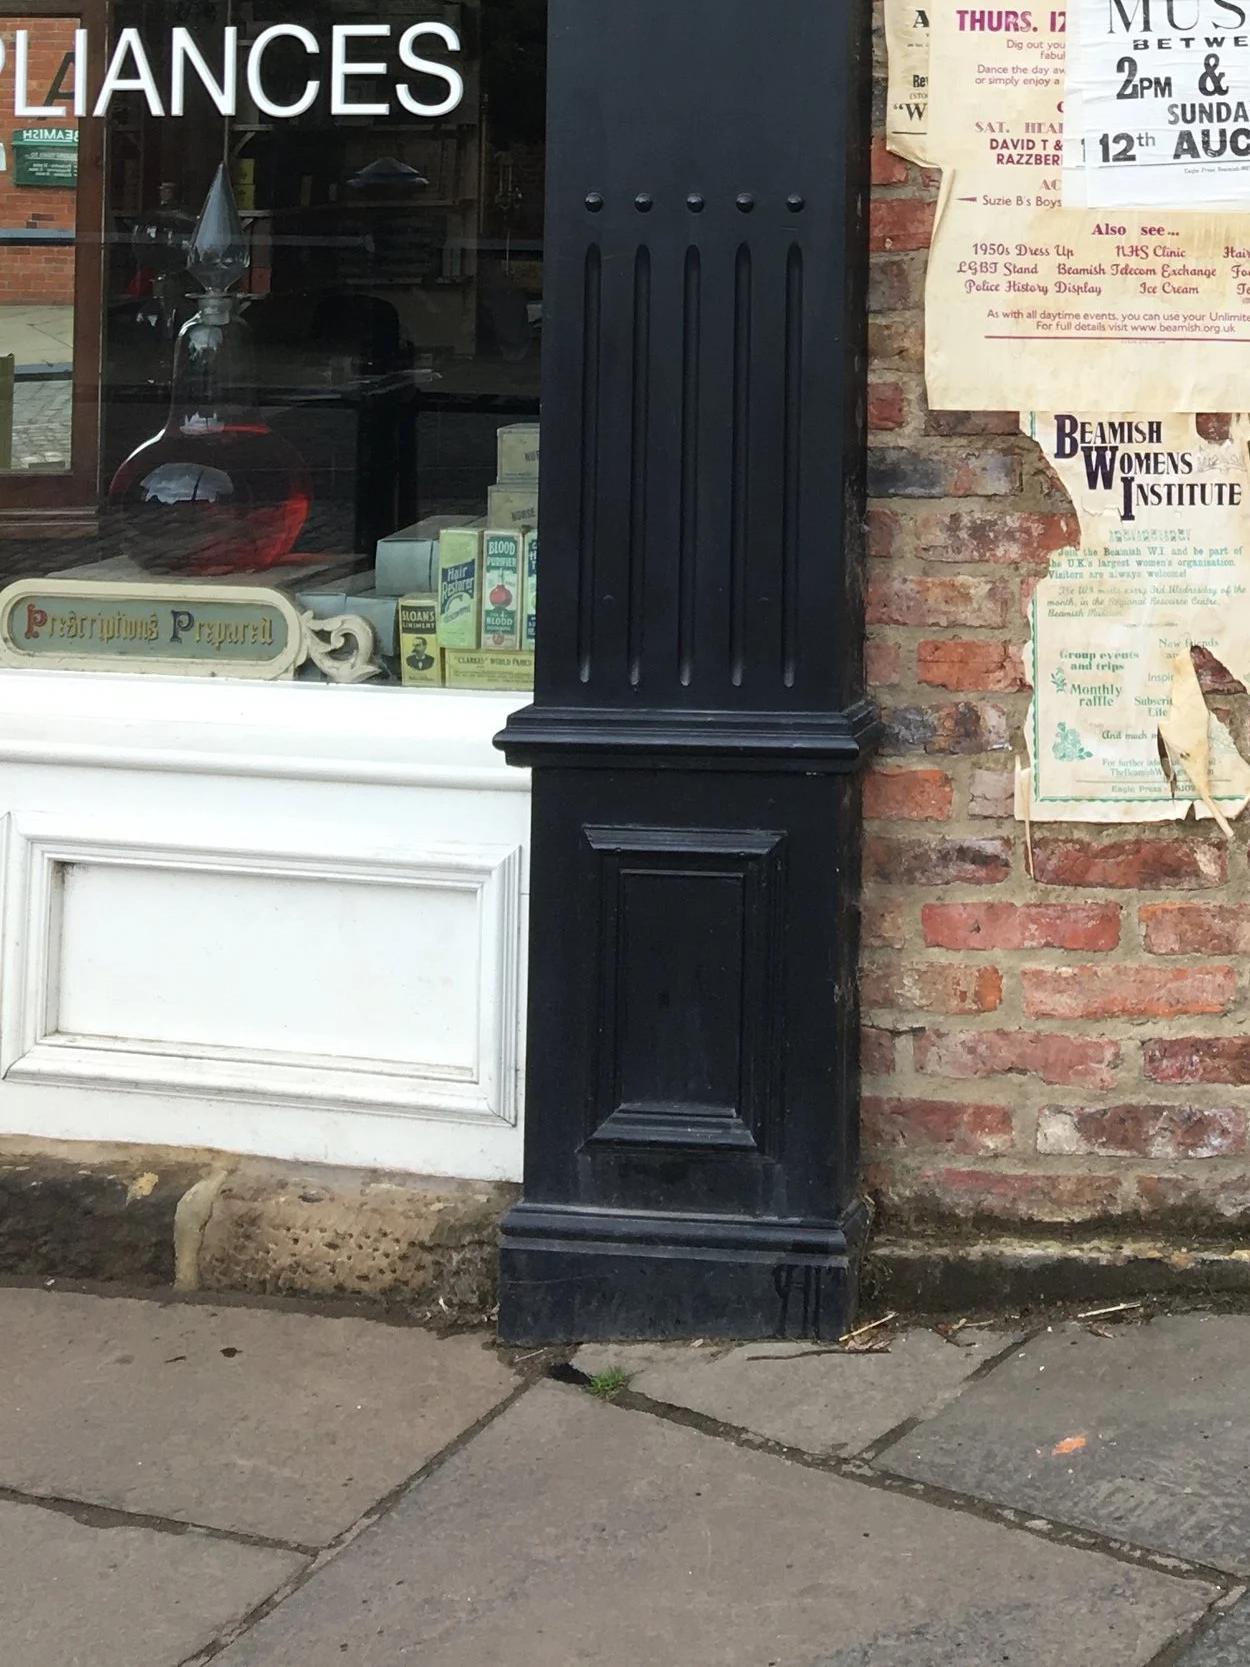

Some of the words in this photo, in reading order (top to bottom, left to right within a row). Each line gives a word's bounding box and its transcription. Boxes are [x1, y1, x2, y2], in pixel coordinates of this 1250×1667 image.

[956, 10, 1038, 32] THURS.
[1007, 39, 1023, 50] Dig
[1027, 40, 1043, 49] out
[0, 22, 464, 118] LIANCES
[978, 65, 1008, 74] Dance
[1012, 65, 1028, 74] the
[1032, 65, 1049, 76] day
[989, 75, 1019, 87] simply
[1023, 76, 1049, 86] enjoy
[1116, 56, 1172, 100] 2PM
[1198, 53, 1229, 96] &
[975, 122, 1010, 133] SAT.
[990, 139, 1035, 150] DAVID
[1041, 140, 1049, 150] T
[1054, 139, 1063, 150] &
[1099, 132, 1156, 163] 12th
[997, 154, 1062, 166] RAZZBER
[982, 195, 1011, 206] Suzie
[1036, 196, 1062, 207] Boys
[1092, 223, 1126, 236] Also
[972, 243, 1011, 256] 1950s
[1015, 244, 1050, 257] Dress
[1054, 245, 1074, 259] Up
[1116, 245, 1149, 259] NHS
[1153, 245, 1186, 258] Clinic
[956, 261, 999, 276] LGBT
[1003, 262, 1039, 276] Stand
[1056, 263, 1106, 276] Beamish
[1110, 265, 1157, 276] Telecom
[1161, 264, 1216, 279] Exchange
[965, 279, 1000, 294] Police
[1004, 280, 1049, 295] History
[1054, 281, 1102, 296] Display
[1139, 282, 1158, 295] Ice
[1162, 282, 1199, 295] Cream
[987, 310, 999, 319] As
[1002, 310, 1023, 319] with
[1026, 310, 1037, 319] all
[1040, 310, 1080, 322] daytime
[1122, 313, 1140, 323] you
[1182, 314, 1205, 323] your
[1037, 322, 1052, 330] For
[1056, 322, 1072, 331] full
[1074, 322, 1106, 331] details
[1108, 322, 1127, 332] visit
[1131, 323, 1235, 334] www.beamish.org.uk
[1054, 414, 1162, 459] BEAMISH
[1081, 446, 1193, 490] WOMENS
[1120, 477, 1242, 521] INSTITUTE
[488, 541, 515, 555] BLOOD
[1058, 547, 1078, 556] Join
[1083, 547, 1098, 556] the
[1104, 547, 1142, 556] Beamish
[1171, 547, 1188, 556] and
[1193, 547, 1204, 556] be
[1209, 547, 1228, 558] part
[1234, 546, 1243, 556] of
[487, 557, 515, 566] PURIFIER
[1098, 559, 1129, 569] largest
[1136, 559, 1172, 567] women's
[447, 567, 468, 581] Hair
[1048, 570, 1083, 579] Visitors
[1089, 571, 1103, 579] are
[1109, 570, 1142, 580] always
[1148, 570, 1187, 579] welcome!
[1169, 586, 1217, 596] Wednesday
[1221, 586, 1230, 596] of
[1234, 586, 1246, 594] the
[1080, 598, 1088, 606] in
[1092, 598, 1103, 606] the
[1048, 610, 1083, 618] Beamish
[24, 603, 159, 644] Prescriptions
[169, 610, 275, 651] Prepared
[1159, 638, 1181, 647] New
[1060, 650, 1096, 661] Group
[1100, 650, 1139, 660] events
[1071, 661, 1092, 671] and
[1096, 662, 1125, 672] trips
[1070, 684, 1122, 696] Monthly
[1079, 696, 1114, 707] raffle
[1102, 731, 1122, 740] And
[1125, 731, 1147, 739] much
[1102, 758, 1115, 766] For
[1119, 758, 1143, 766] further
[1112, 785, 1135, 794] Eagle
[1139, 785, 1162, 793] Press
